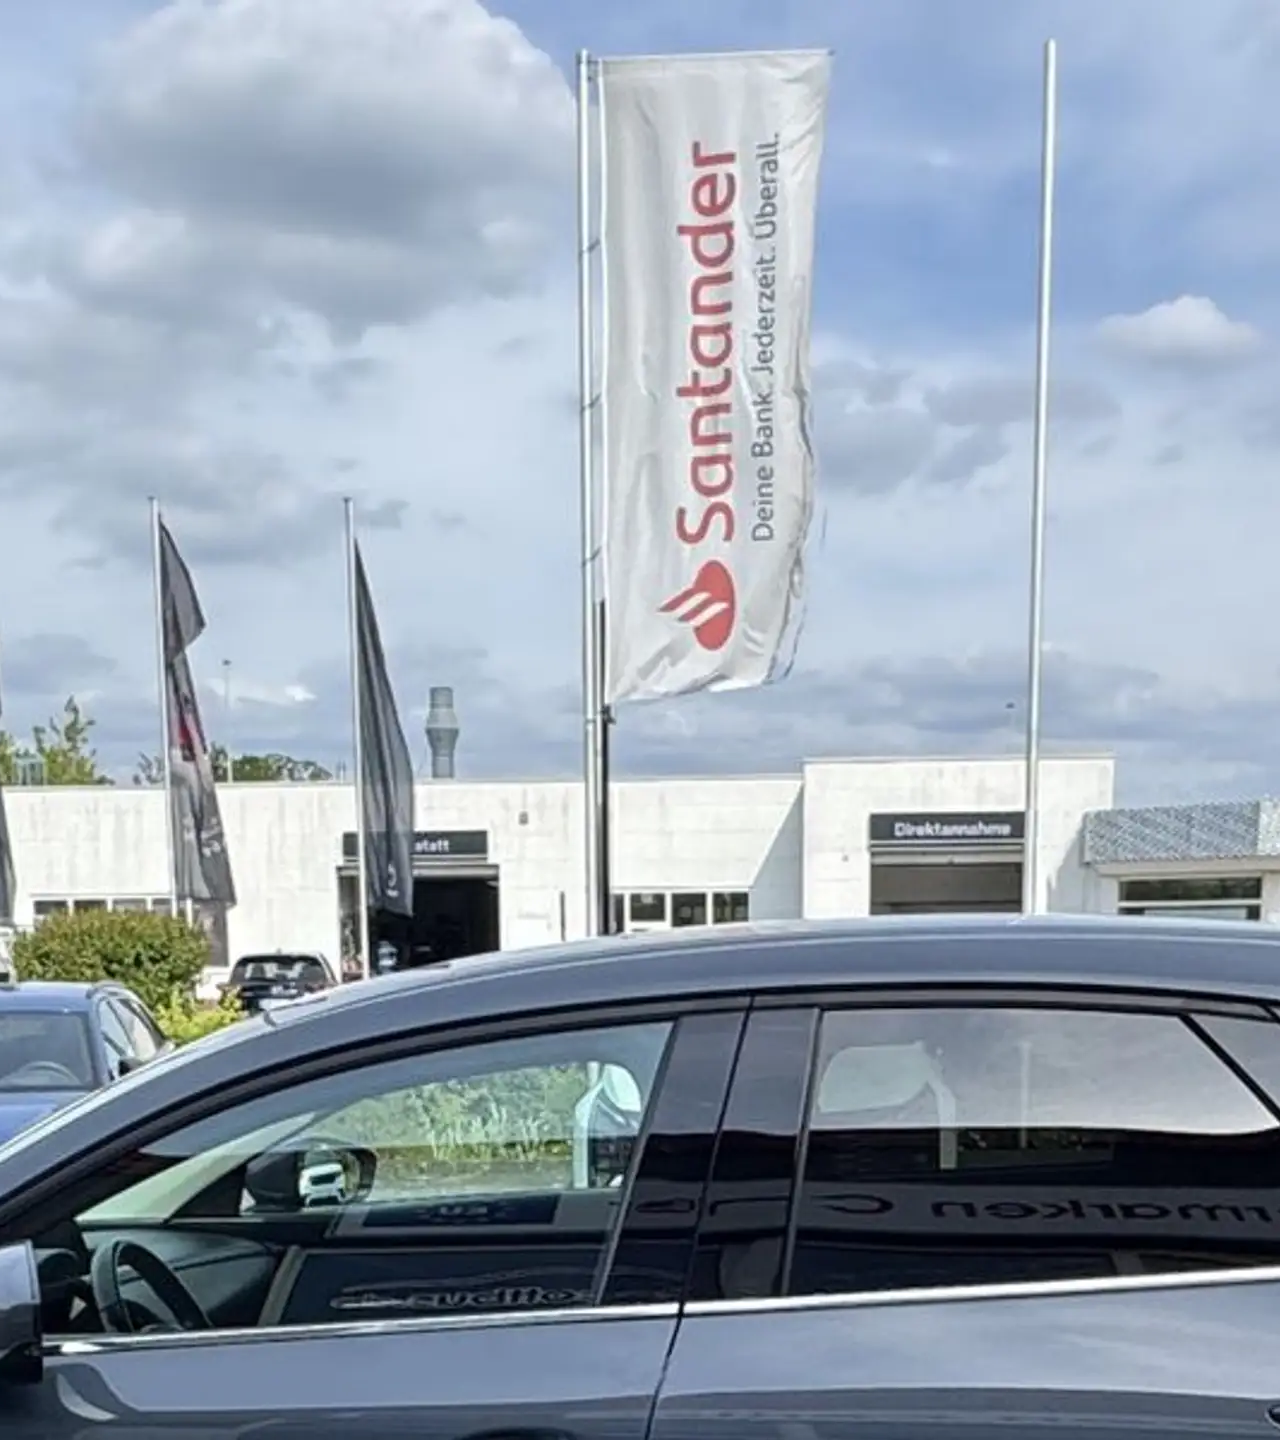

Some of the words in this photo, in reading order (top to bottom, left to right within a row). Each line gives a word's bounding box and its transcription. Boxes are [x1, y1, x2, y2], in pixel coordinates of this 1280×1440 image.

[676, 140, 737, 545] Santander
[750, 247, 776, 375] Jederzeit.
[750, 382, 774, 459] Bank.
[751, 465, 775, 542] Deine
[893, 821, 1012, 838] Direktannahme
